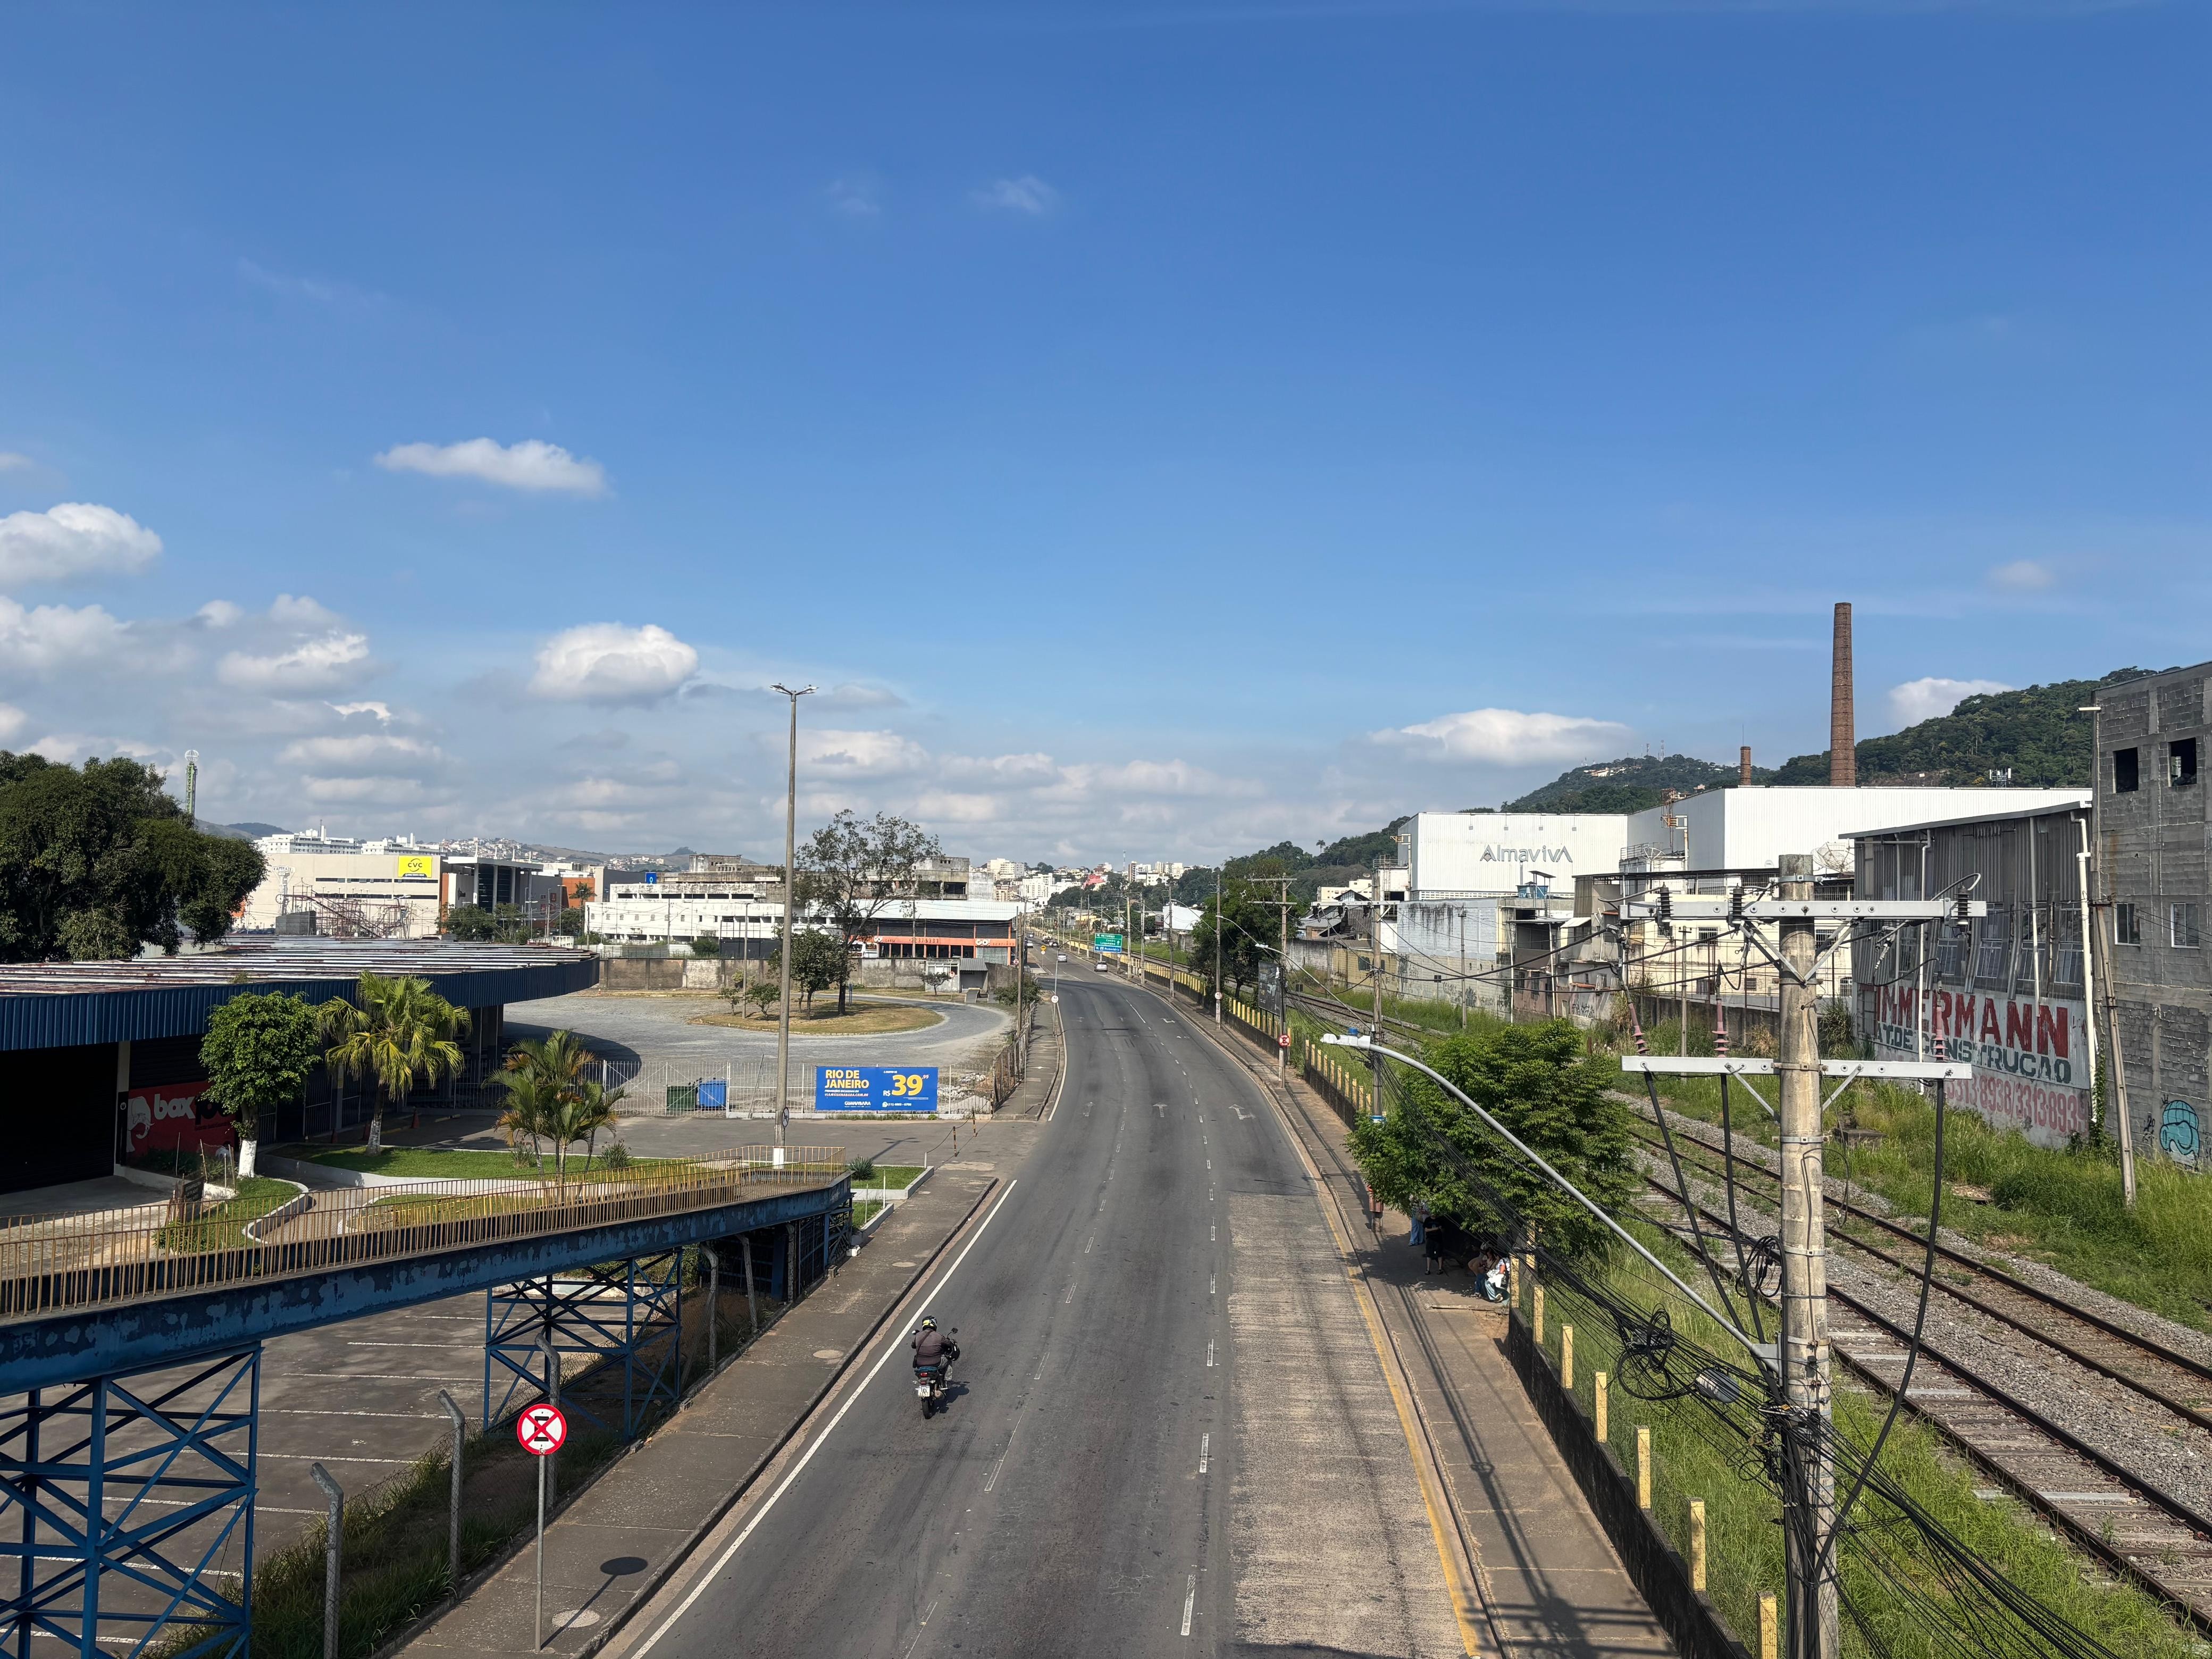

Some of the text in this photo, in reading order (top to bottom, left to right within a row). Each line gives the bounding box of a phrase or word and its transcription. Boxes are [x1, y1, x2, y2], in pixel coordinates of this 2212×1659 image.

[825, 1070, 860, 1079] RIO DE
[825, 1079, 869, 1088] JANEIRO
